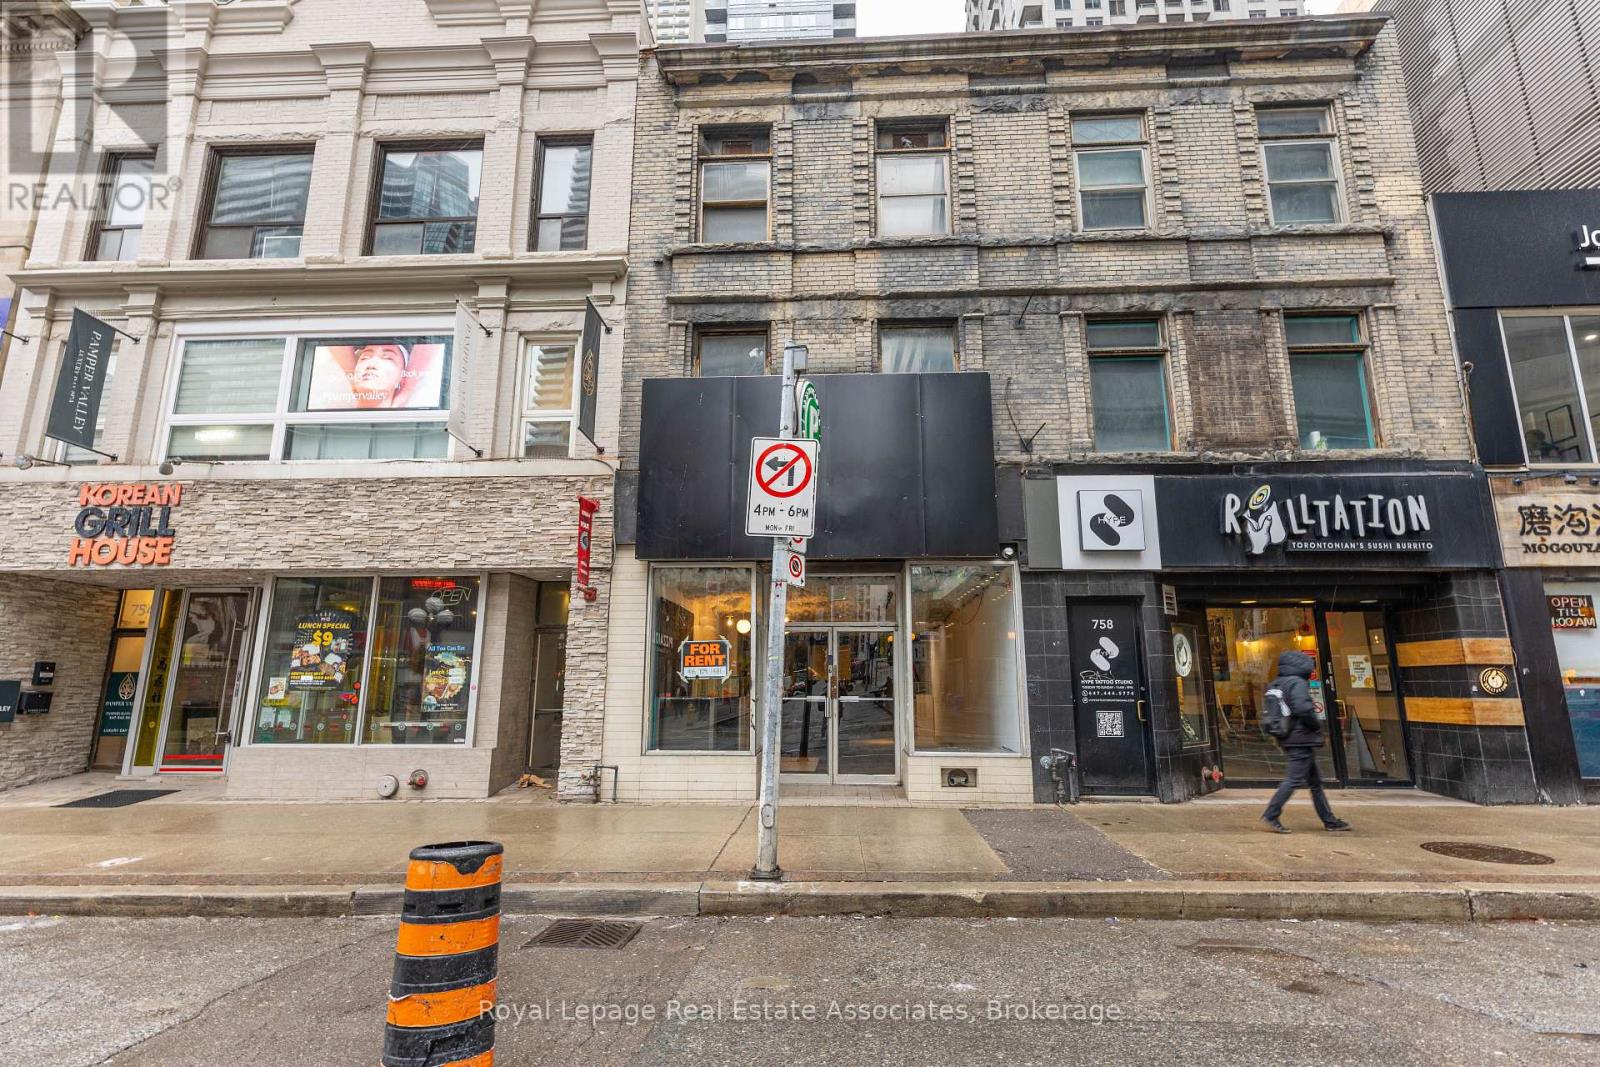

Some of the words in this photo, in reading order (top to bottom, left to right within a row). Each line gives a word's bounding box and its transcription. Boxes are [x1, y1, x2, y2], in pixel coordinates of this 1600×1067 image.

[84, 330, 102, 382] PAMPER
[73, 384, 91, 434] VALLEY
[79, 482, 183, 507] KOREAN
[754, 504, 775, 516] 4PM
[788, 505, 808, 517] 6PM
[74, 506, 176, 539] GRILL
[1097, 516, 1126, 525] HYPE
[1518, 503, 1600, 537] 磨沟
[68, 537, 176, 566] HOUSE
[1292, 541, 1364, 550] TORONTONIAN'S
[1367, 541, 1392, 550] SUSHI
[1396, 541, 1433, 550] BURRITO
[1551, 596, 1588, 608] OPEN
[1556, 607, 1586, 617] TILL
[1091, 619, 1114, 630] 758
[1575, 617, 1596, 627] AM
[311, 630, 334, 646] $9
[690, 643, 721, 655] FOR
[684, 655, 726, 667] RENT
